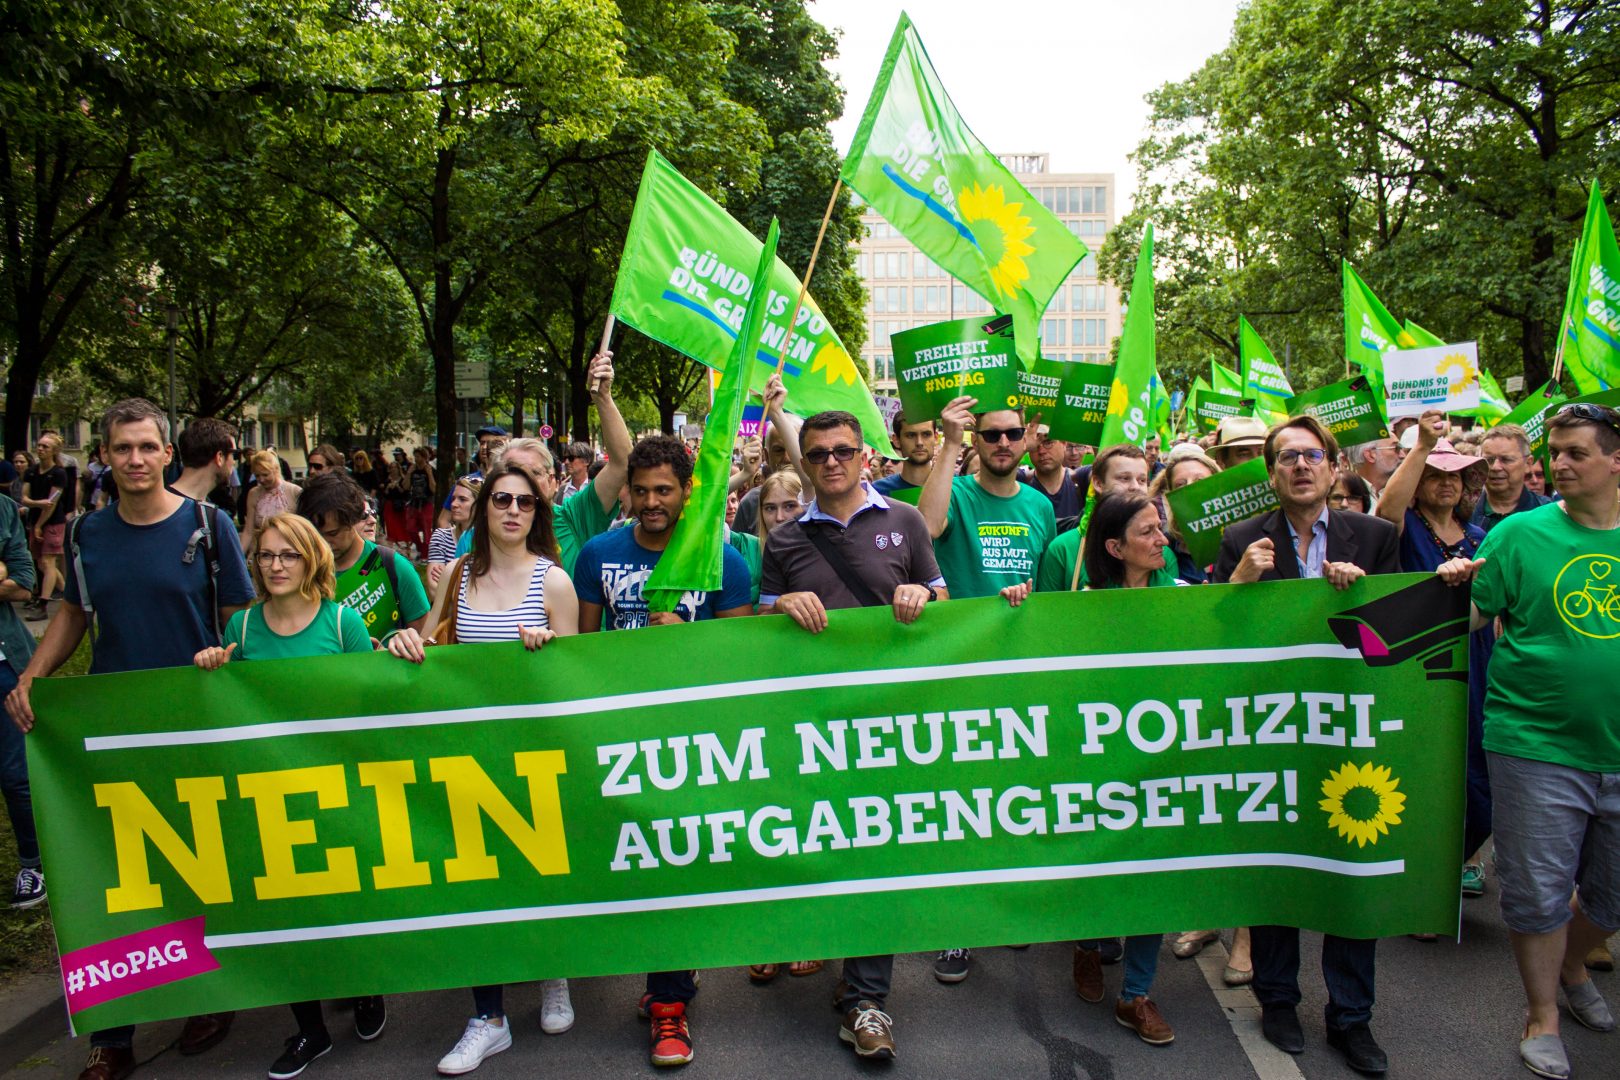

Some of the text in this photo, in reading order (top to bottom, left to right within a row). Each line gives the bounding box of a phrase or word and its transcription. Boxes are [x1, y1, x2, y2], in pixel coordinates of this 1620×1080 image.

[679, 246, 825, 336] BÜNDIS 90
[669, 266, 816, 363] DIE GRNEN
[915, 340, 988, 363] FREIHEIT
[902, 354, 1008, 382] VERTEIDIGEN!
[925, 372, 985, 393] #NoPAG
[1082, 383, 1112, 397] FREI
[1390, 387, 1448, 400] DIE GRÜNEN
[1391, 376, 1449, 390] BÜNDNIS 90
[1065, 394, 1108, 411] VERTE
[1201, 480, 1272, 515] FREIHEI
[1187, 492, 1278, 534] VERTEIDIG
[978, 525, 1029, 536] ZUKUNFT
[979, 537, 1011, 547] WIRD
[982, 548, 1028, 558] AUS MUT
[982, 558, 1033, 570] GEMACHT
[597, 692, 1404, 797] ZUM NEUEN POLIZEI-
[610, 769, 1299, 871] AUFGABENGESETZ!
[93, 750, 571, 914] NEIN
[67, 940, 188, 995] #NoPAG
